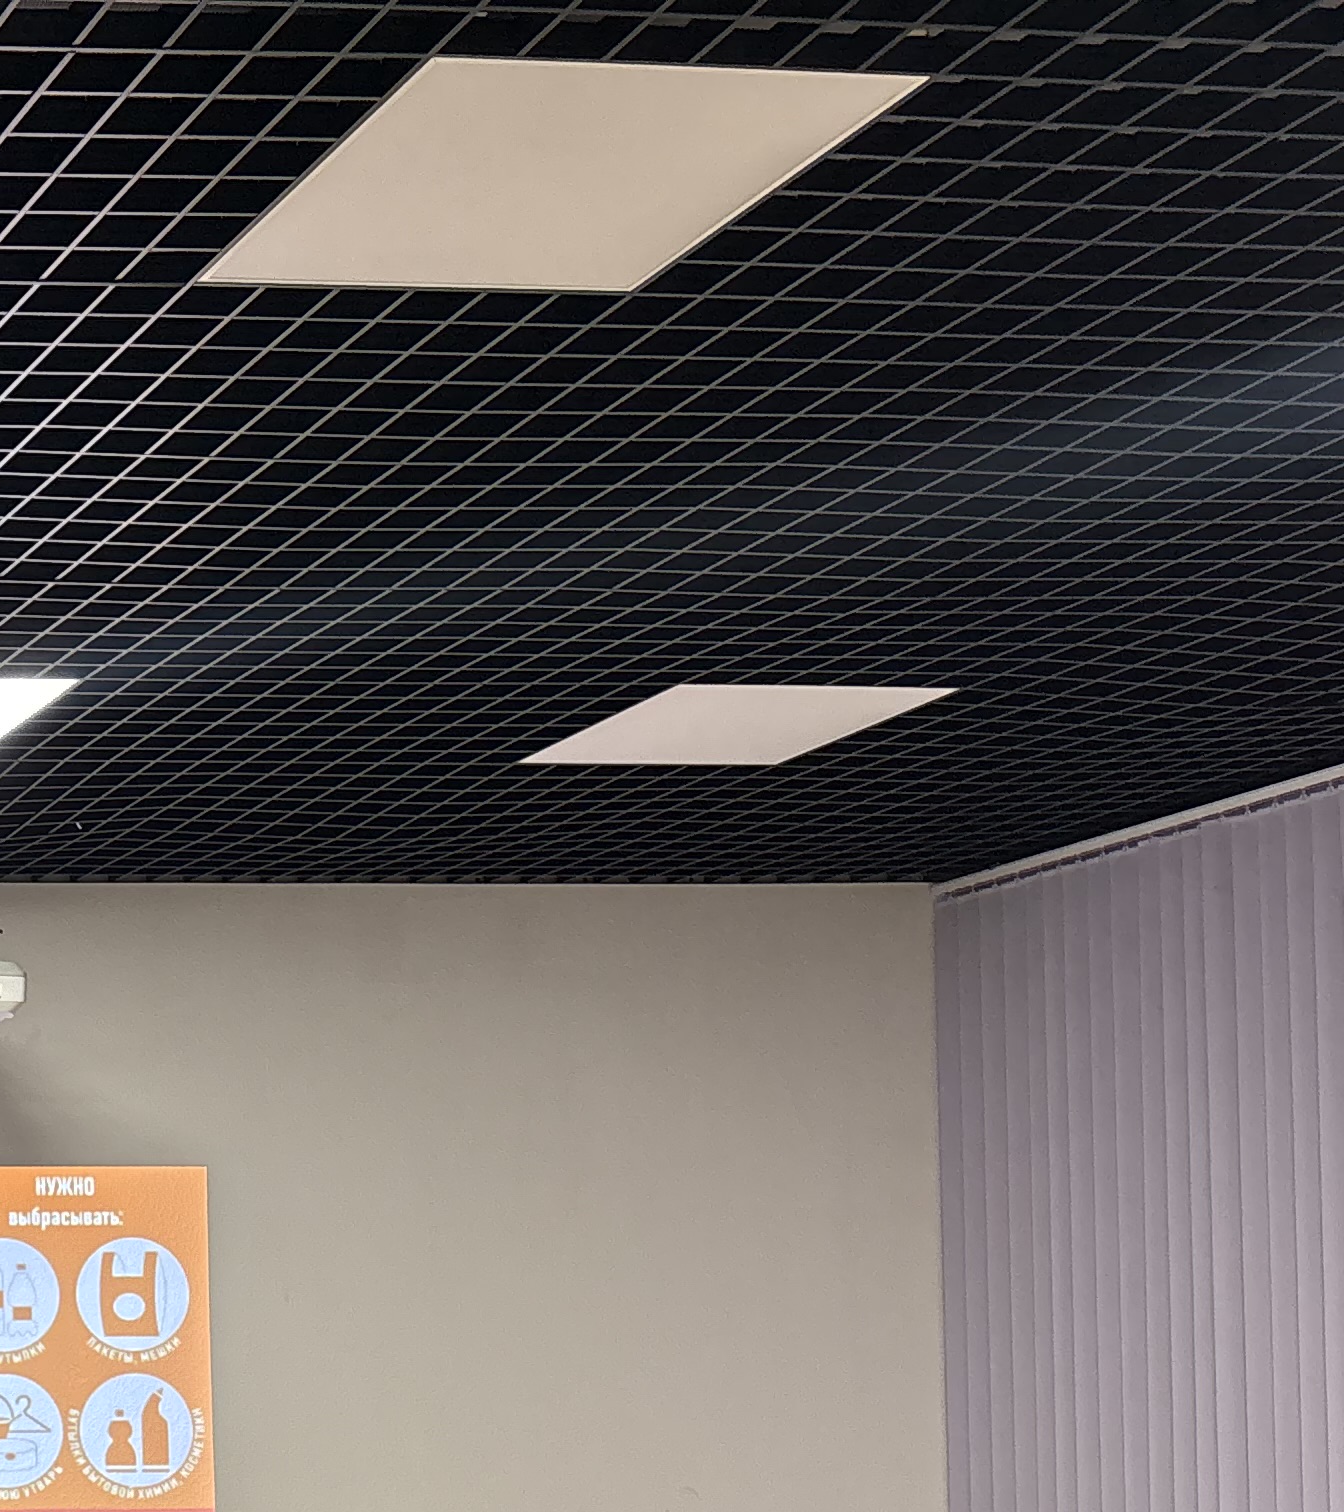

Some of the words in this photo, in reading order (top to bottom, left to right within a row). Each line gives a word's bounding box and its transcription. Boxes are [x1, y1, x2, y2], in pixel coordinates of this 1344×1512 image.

[35, 1176, 95, 1197] НУЖНО
[8, 1206, 124, 1231] выбрасывать:
[85, 1336, 138, 1365] ПАКЕТЫ,
[140, 1337, 182, 1363] МЕШКИ
[67, 1407, 86, 1466] БУТЫЛКИ
[82, 1465, 135, 1499] БЫТОВОЙ
[179, 1407, 207, 1480] КОСМЕТИКИ
[22, 1465, 64, 1499] УТВАРЬ
